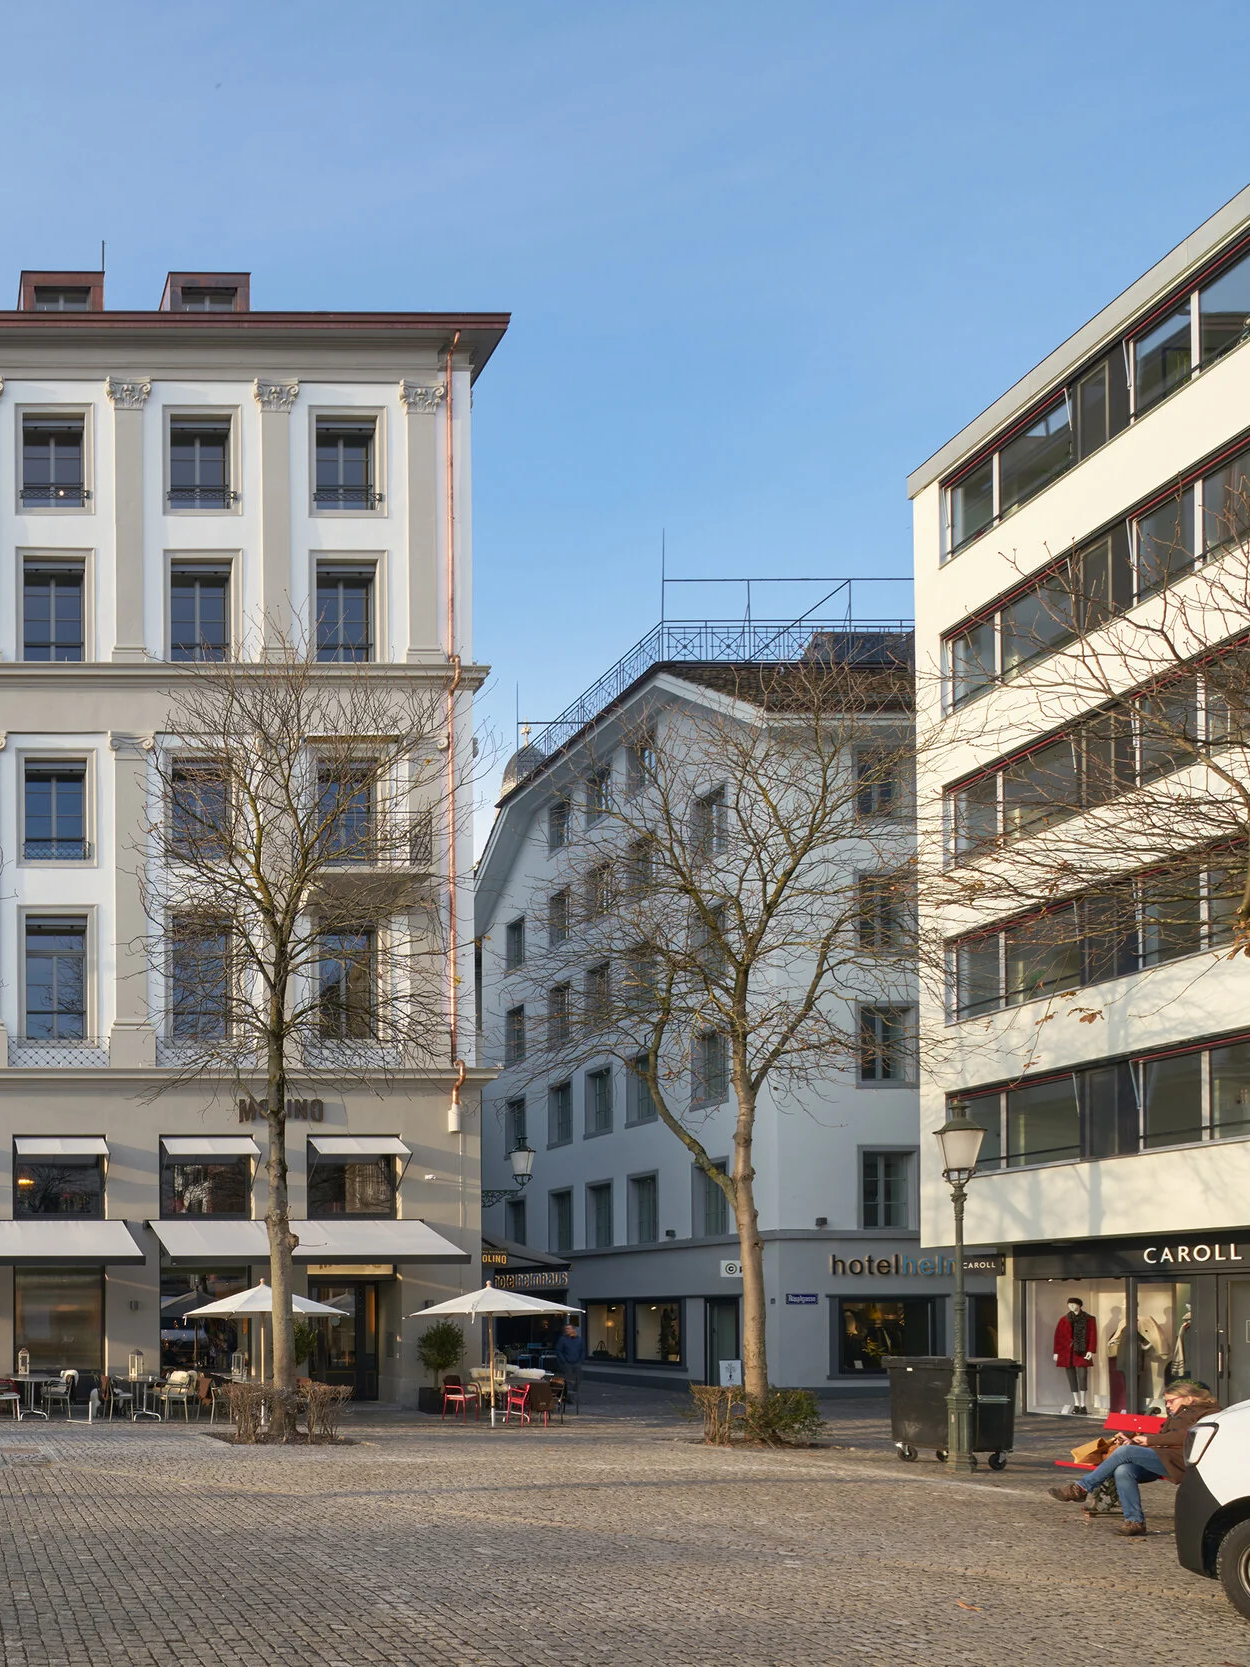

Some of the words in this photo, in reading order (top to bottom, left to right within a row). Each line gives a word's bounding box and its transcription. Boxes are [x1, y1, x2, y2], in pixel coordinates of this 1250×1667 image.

[239, 1098, 324, 1124] MOINO
[482, 1254, 507, 1265] OLINO
[1143, 1243, 1243, 1264] CAROLL
